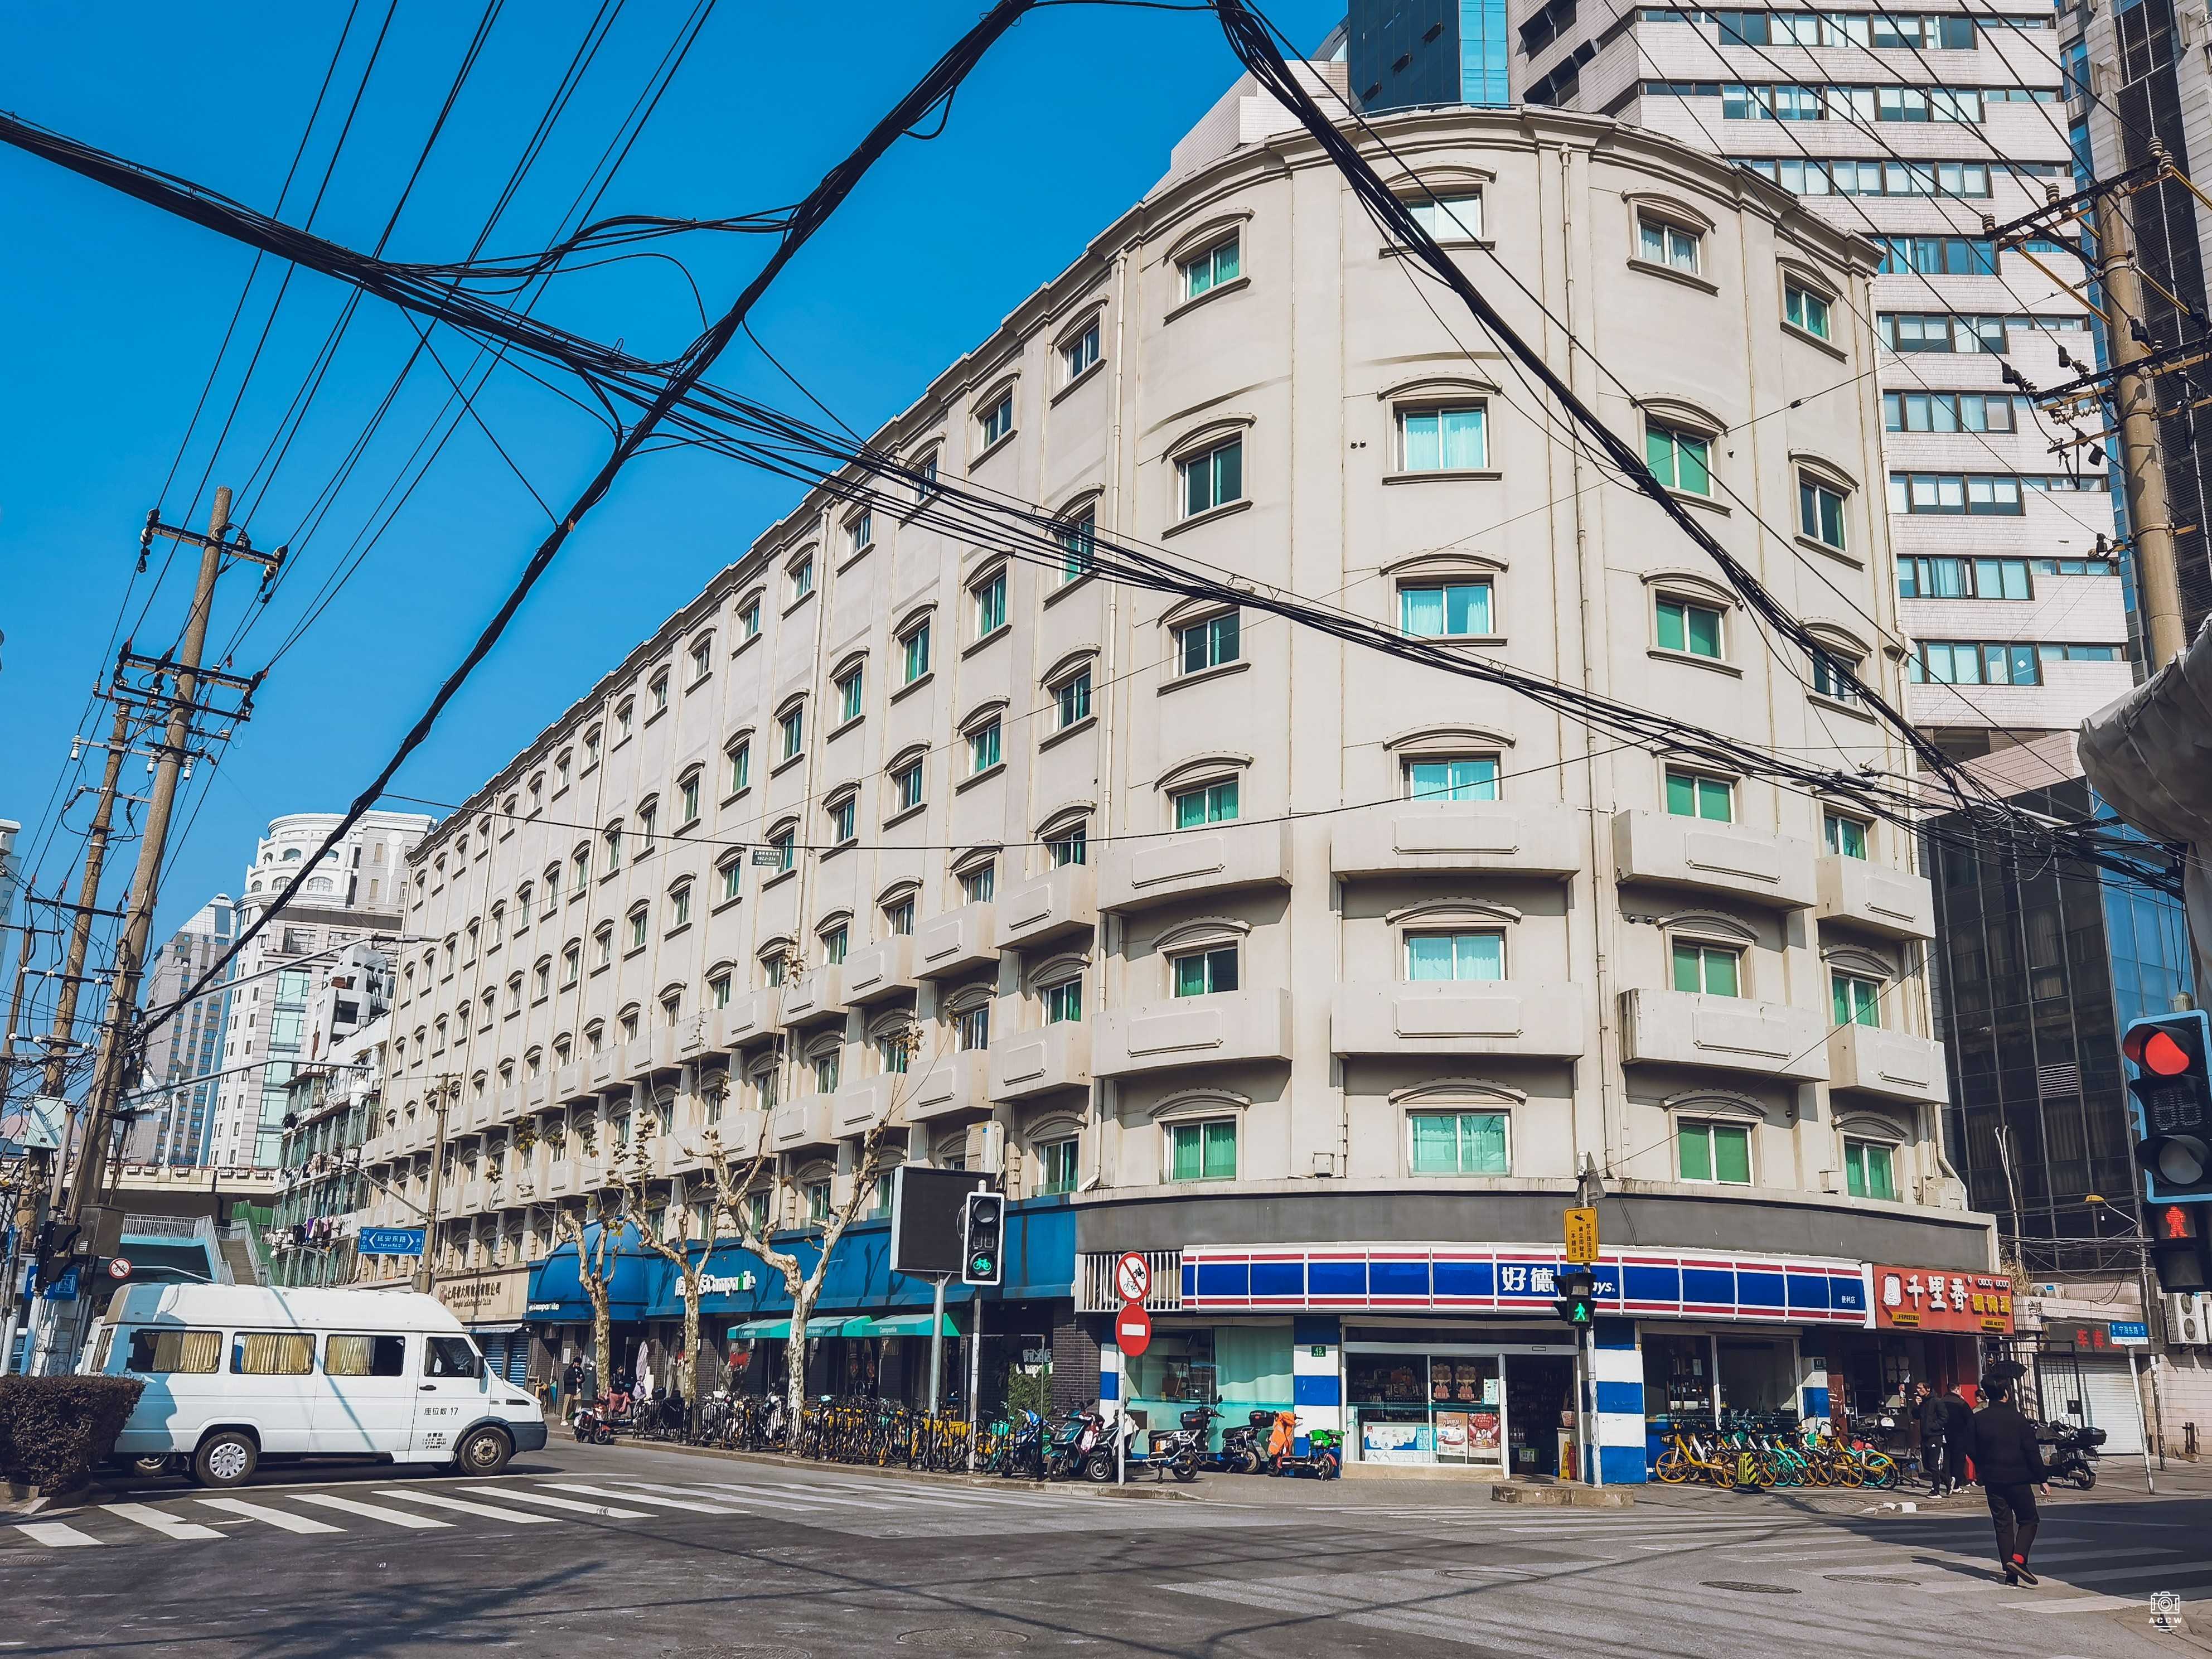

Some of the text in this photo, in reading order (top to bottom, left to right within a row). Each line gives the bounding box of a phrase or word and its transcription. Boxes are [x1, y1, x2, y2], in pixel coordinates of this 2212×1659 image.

[1502, 1266, 1555, 1293] 好德
[1907, 1274, 1969, 1310] 千里香
[451, 1407, 458, 1416] 17
